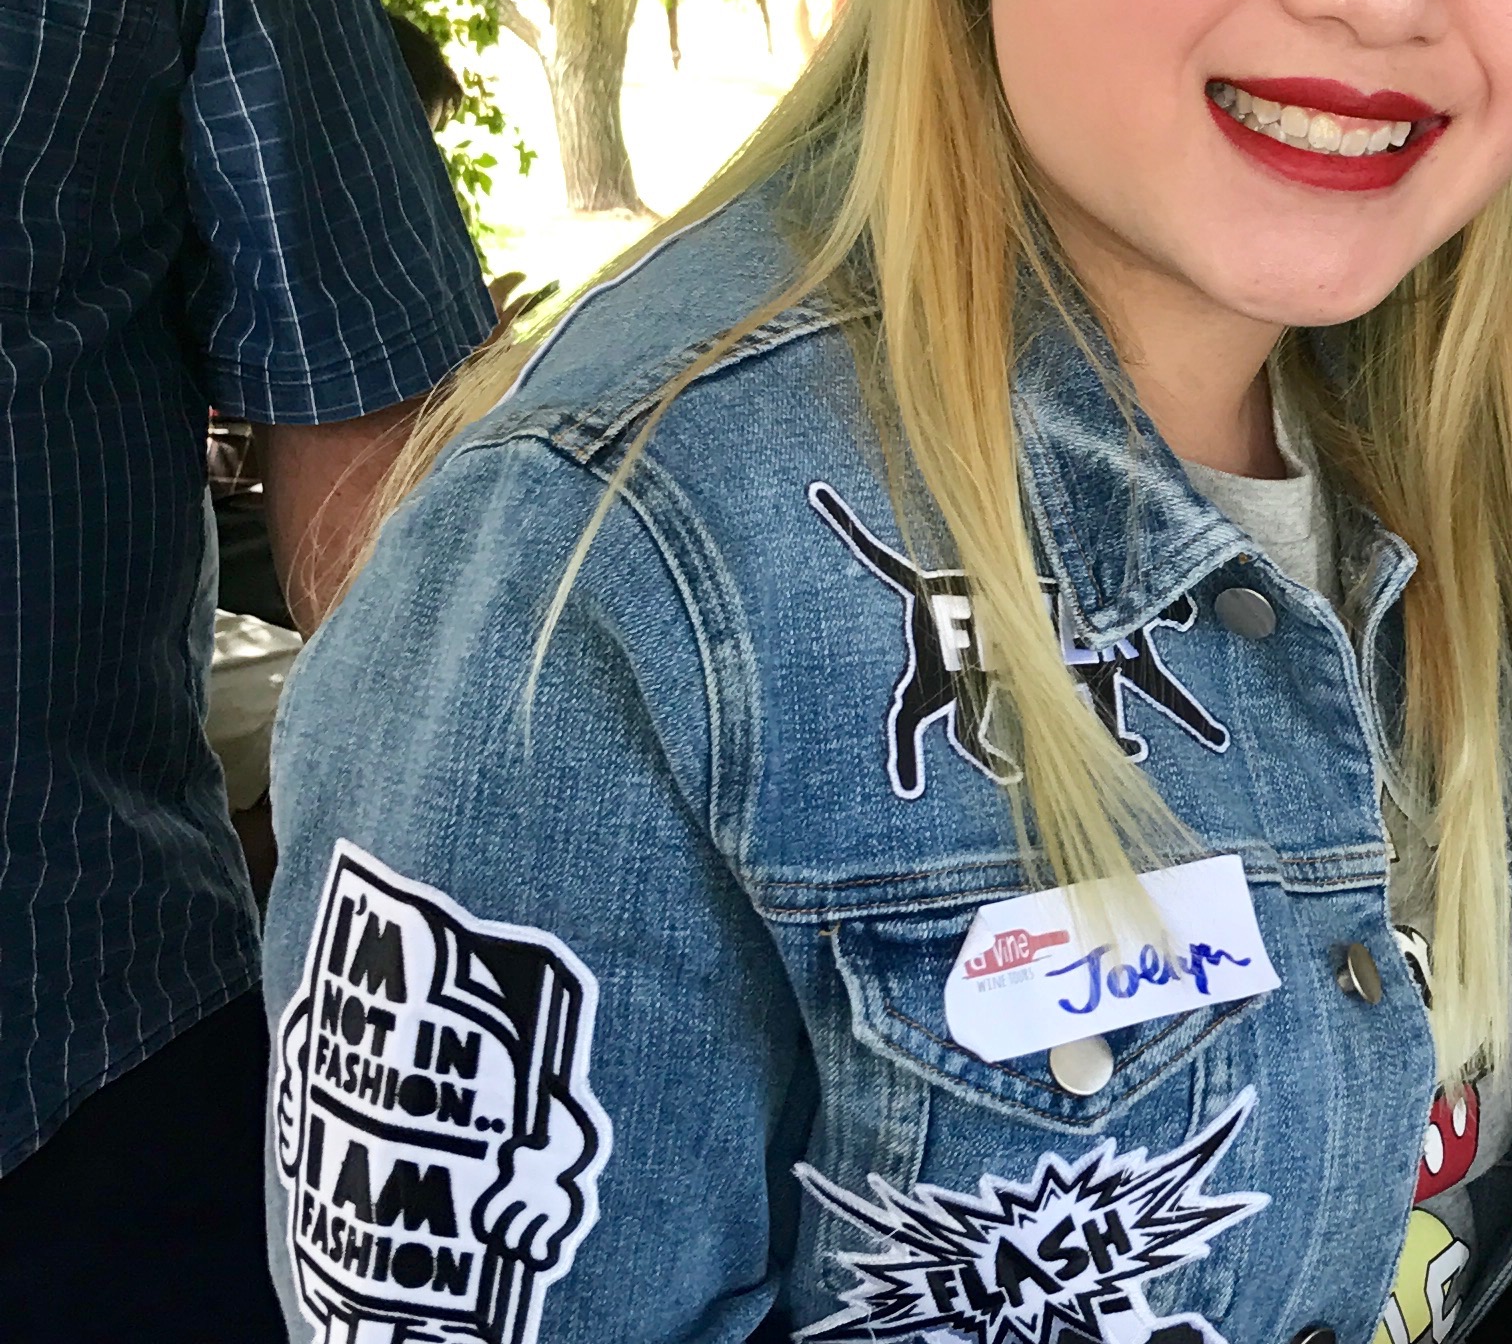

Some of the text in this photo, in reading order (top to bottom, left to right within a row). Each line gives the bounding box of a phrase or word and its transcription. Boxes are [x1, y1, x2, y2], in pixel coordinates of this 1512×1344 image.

[327, 893, 408, 1005] I'M
[320, 978, 481, 1080] NOT IN
[304, 1113, 459, 1239] I AM
[300, 1199, 474, 1298] FASHION
[924, 1210, 1133, 1313] FLASH
